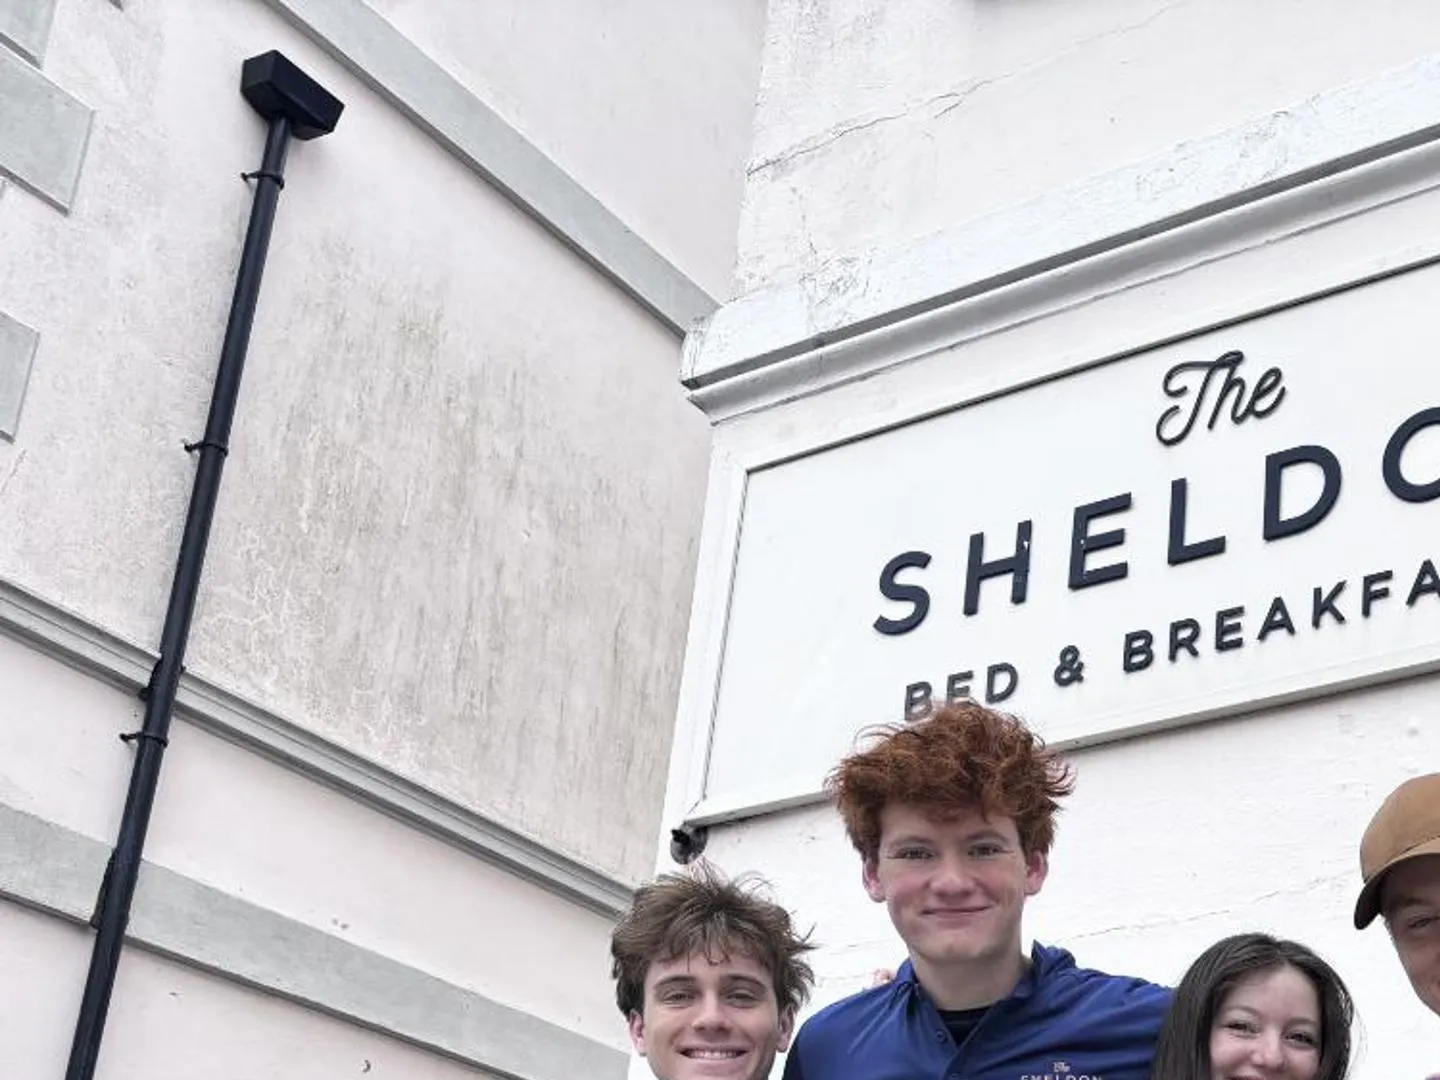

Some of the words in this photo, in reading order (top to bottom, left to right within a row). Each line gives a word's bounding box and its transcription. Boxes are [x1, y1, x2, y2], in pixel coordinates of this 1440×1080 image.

[1156, 350, 1287, 447] The
[904, 662, 1019, 722] BED
[1054, 644, 1085, 687] &
